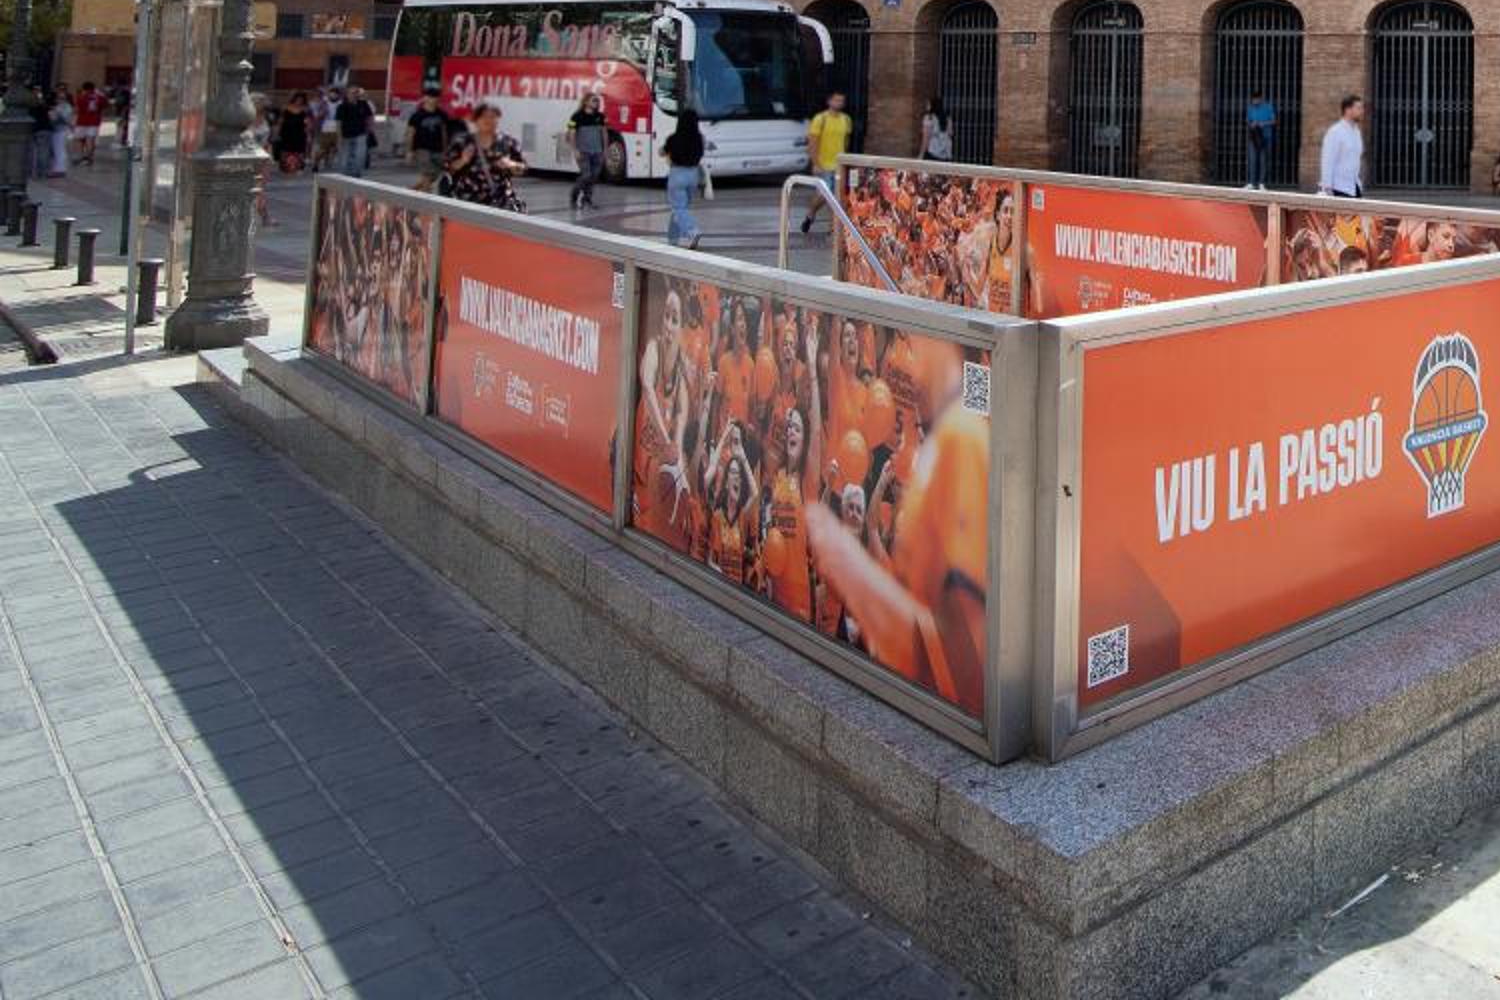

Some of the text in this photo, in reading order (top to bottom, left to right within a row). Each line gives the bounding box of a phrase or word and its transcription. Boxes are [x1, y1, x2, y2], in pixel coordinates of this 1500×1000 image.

[1055, 223, 1237, 283] WWW.VALENCIABASKET.COM
[459, 274, 600, 376] WWW.VALENCIABASKET.COM
[1155, 396, 1384, 543] VIU LA PASSIÓ
